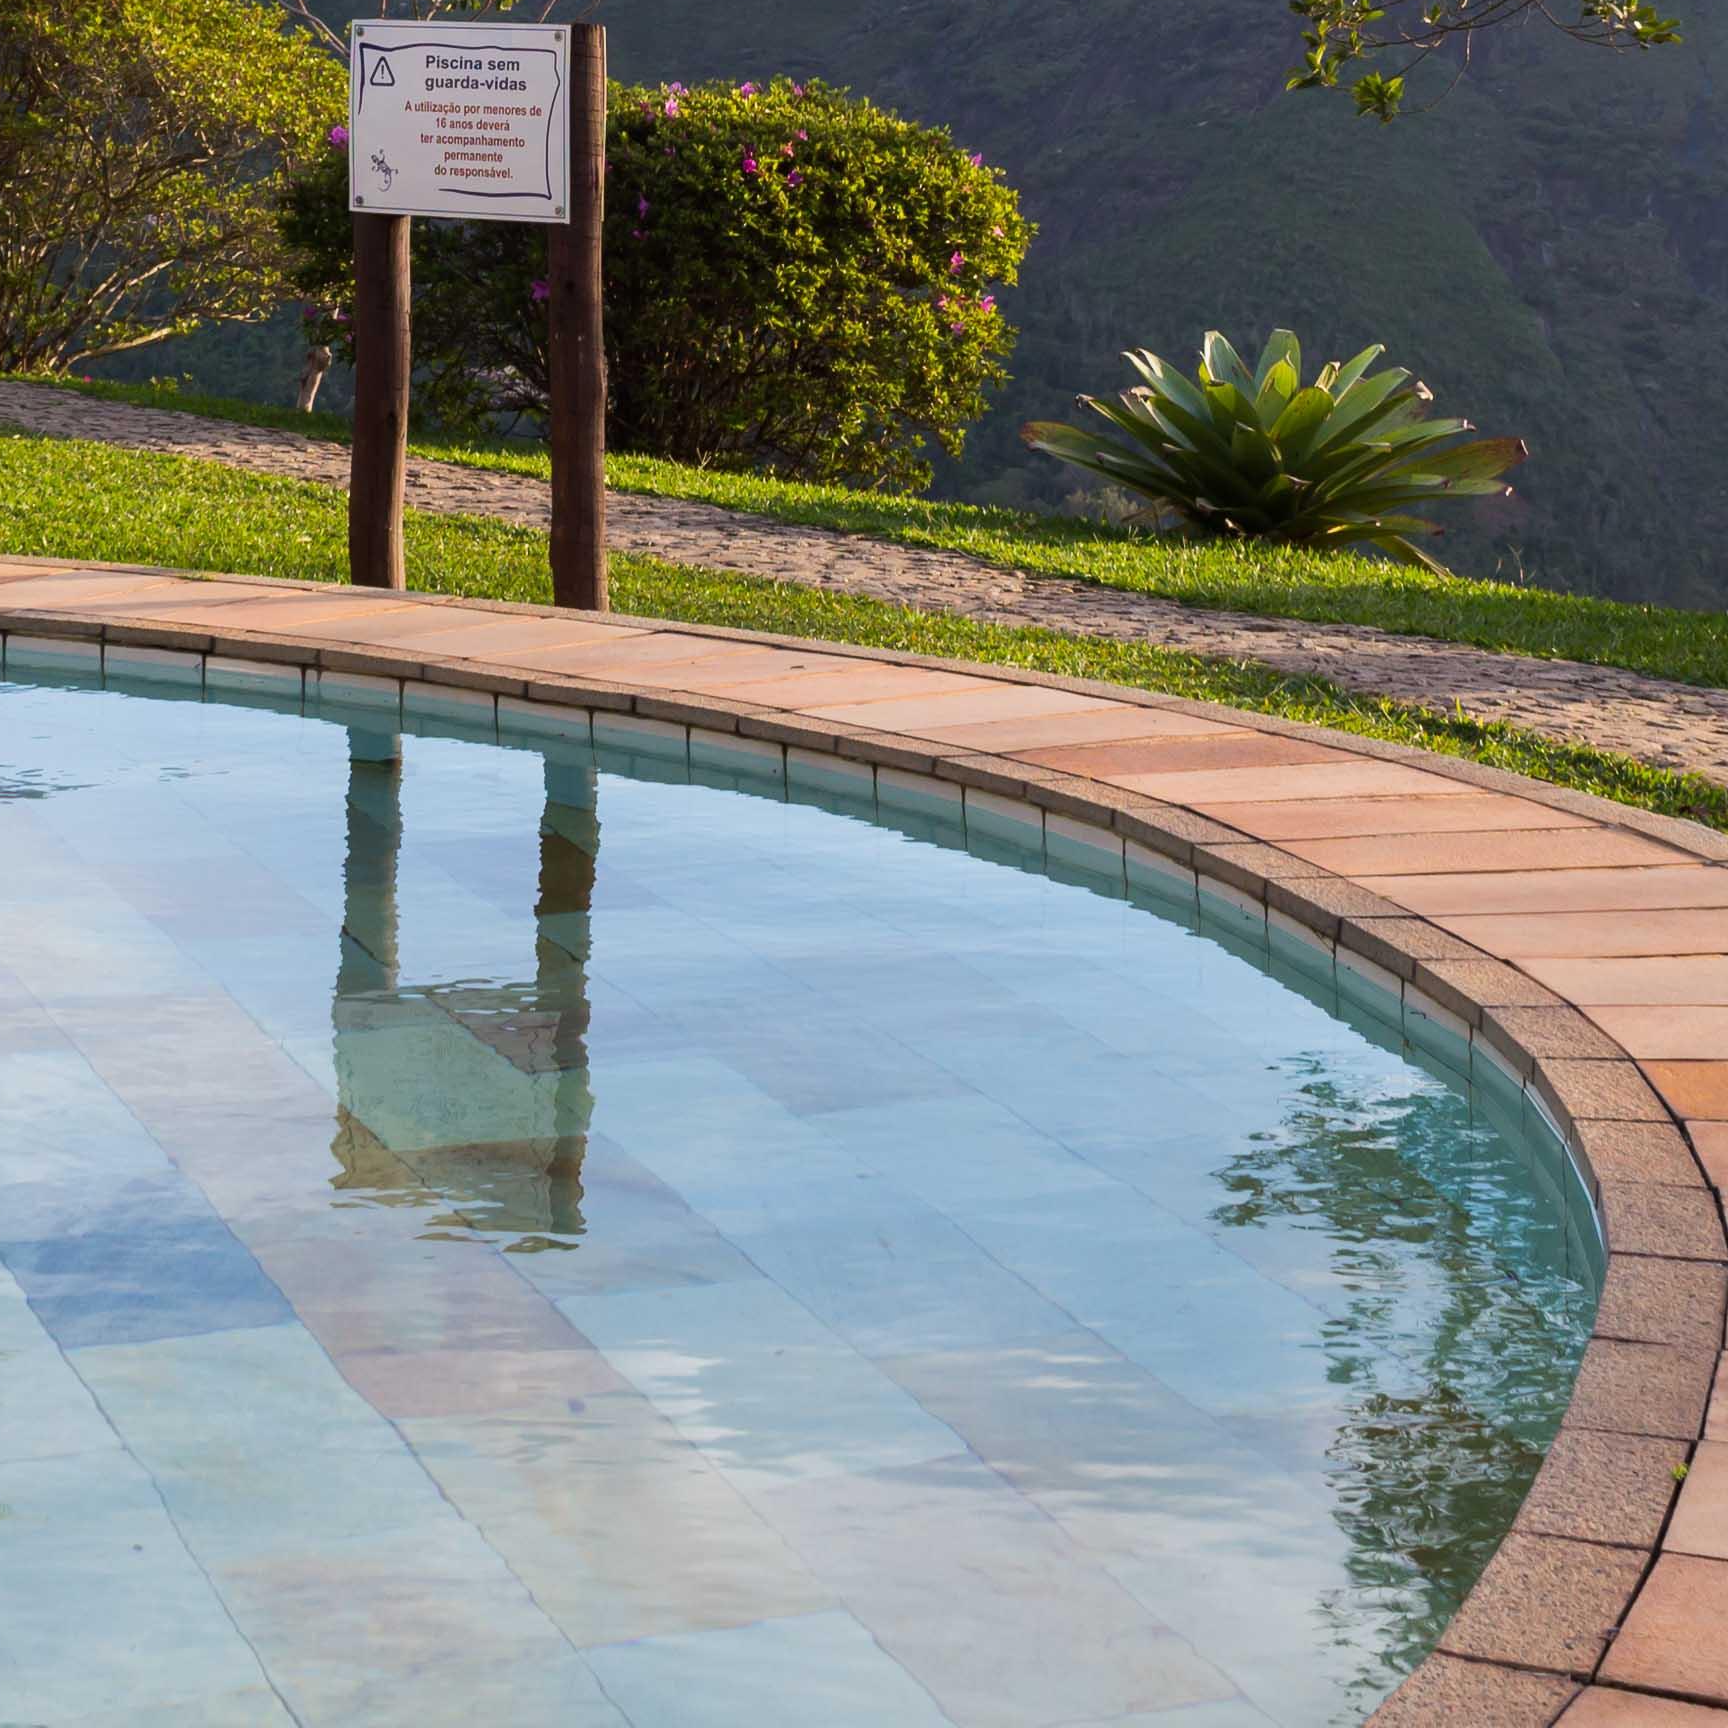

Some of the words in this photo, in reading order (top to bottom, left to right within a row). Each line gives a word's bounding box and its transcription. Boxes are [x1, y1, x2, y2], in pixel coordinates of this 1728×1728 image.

[426, 55, 482, 70] Piscina
[487, 59, 520, 71] sem
[425, 76, 527, 91] guarda-vidas
[405, 101, 412, 111] A
[414, 102, 461, 114] utilização
[463, 105, 480, 116] por
[483, 107, 527, 116] menores
[530, 106, 542, 116] de
[436, 118, 446, 128] 16
[449, 120, 473, 129] anos
[476, 120, 510, 131] deverá
[421, 134, 433, 143] ter
[436, 135, 525, 147] acompanhamento
[444, 151, 503, 163] permanente
[434, 166, 447, 176] do
[449, 167, 513, 179] responsável.
